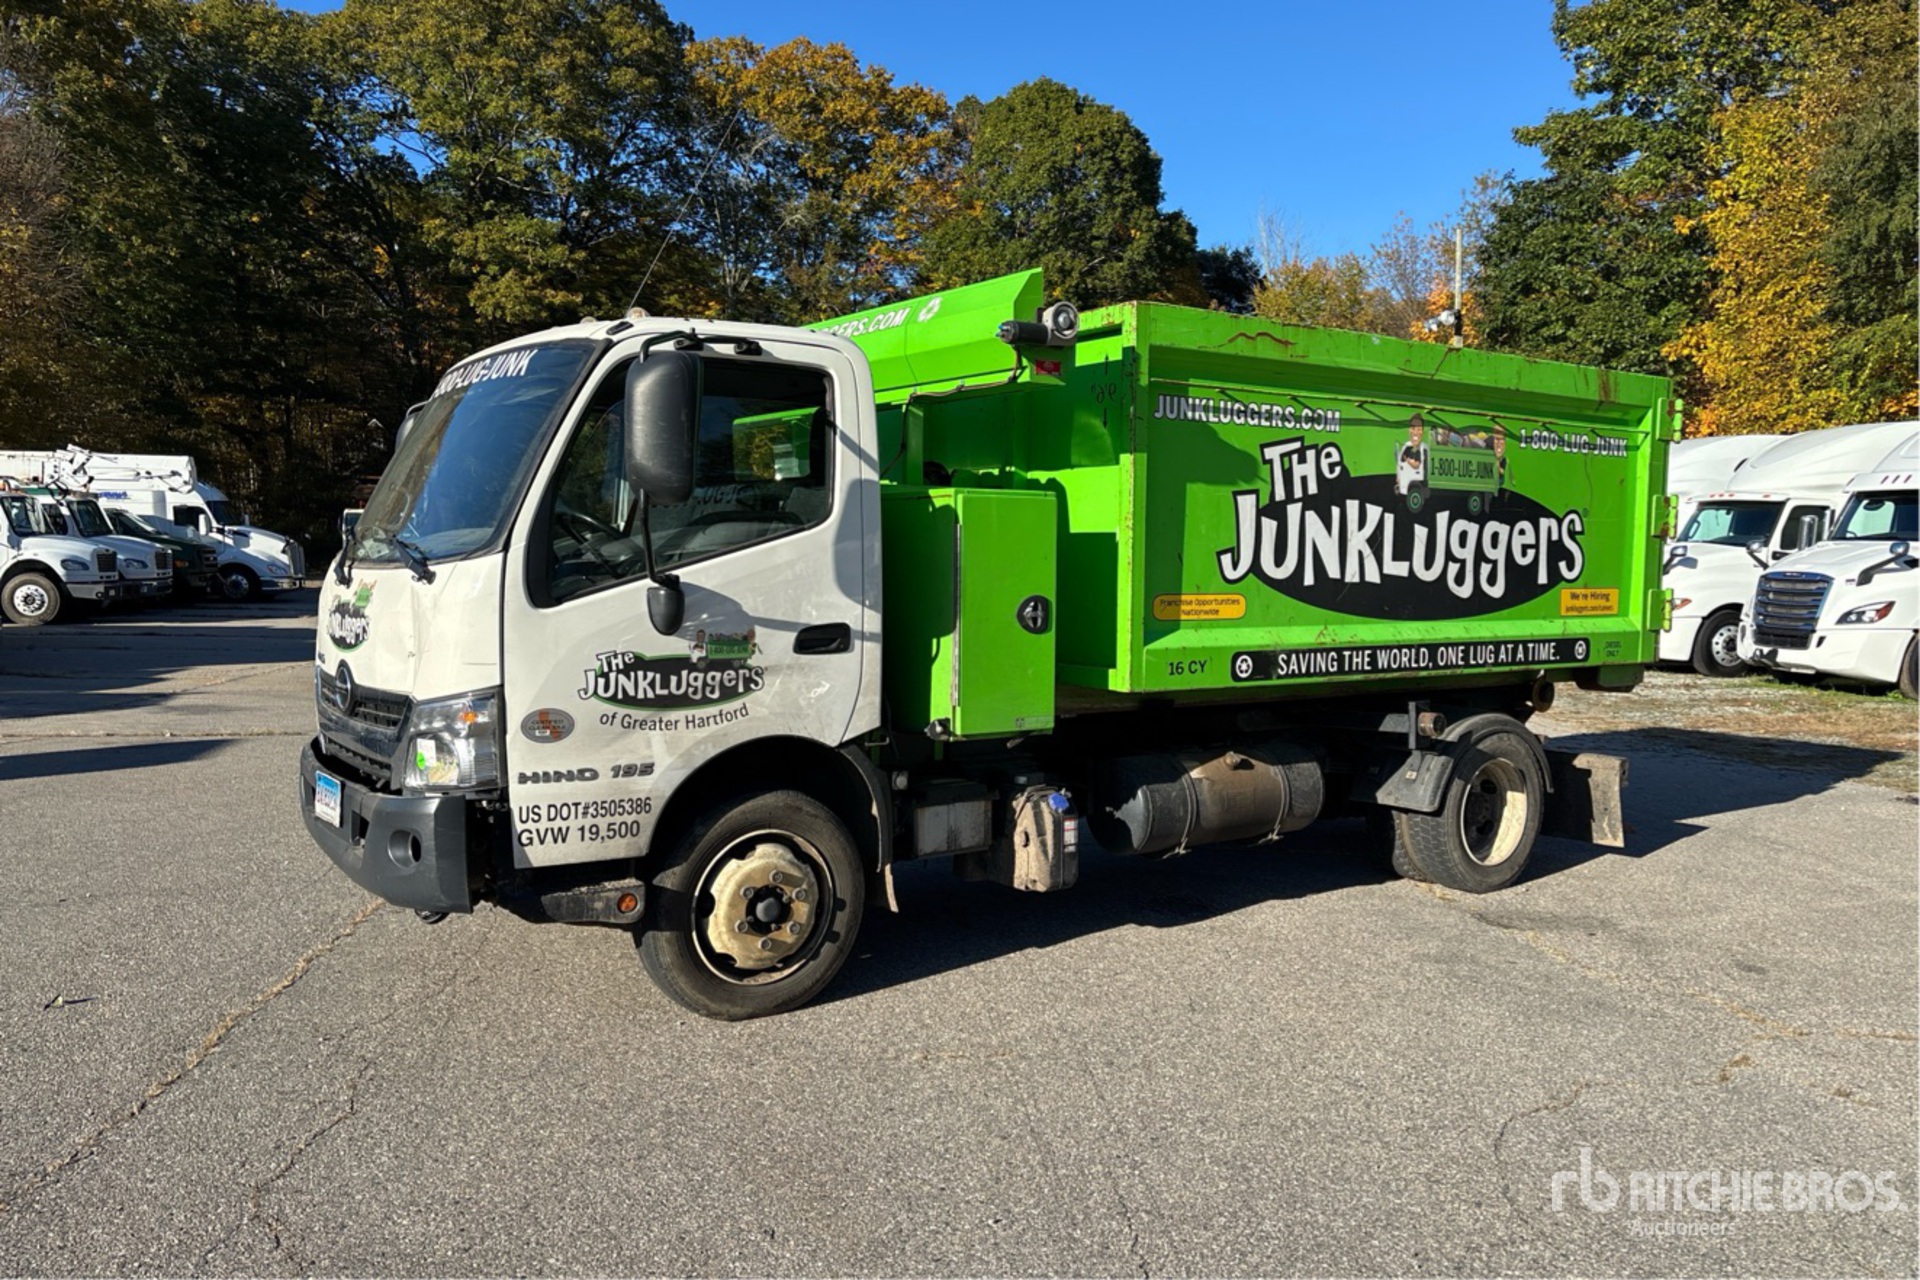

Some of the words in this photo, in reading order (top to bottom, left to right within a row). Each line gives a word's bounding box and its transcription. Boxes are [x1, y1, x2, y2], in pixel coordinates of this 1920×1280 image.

[1154, 395, 1342, 432] JUNKLUGGERS.COM
[1520, 428, 1628, 457] 1-800-LUG-JUNK
[1430, 457, 1495, 480] 1-800-LUG-JUNK
[1194, 598, 1241, 608] Opportunities
[1590, 592, 1611, 603] Hiring
[1168, 661, 1184, 676] 16
[1188, 659, 1207, 674] CY
[1278, 653, 1338, 676] SAVING
[1343, 650, 1372, 671] THE
[1377, 648, 1433, 670] WORLD,
[1437, 645, 1465, 667] ONE
[1469, 645, 1495, 664] LUG
[1498, 643, 1515, 662] AT
[1516, 643, 1525, 662] A
[1527, 641, 1560, 661] TIME.
[600, 711, 617, 726] of
[620, 713, 680, 731] Greater
[685, 702, 749, 730] Hartford
[518, 768, 599, 784] HINO
[610, 762, 655, 778] 195
[519, 805, 542, 824] US
[547, 797, 652, 822] DOT#3505386
[518, 825, 570, 847] GVW
[578, 820, 640, 843] 19,500
